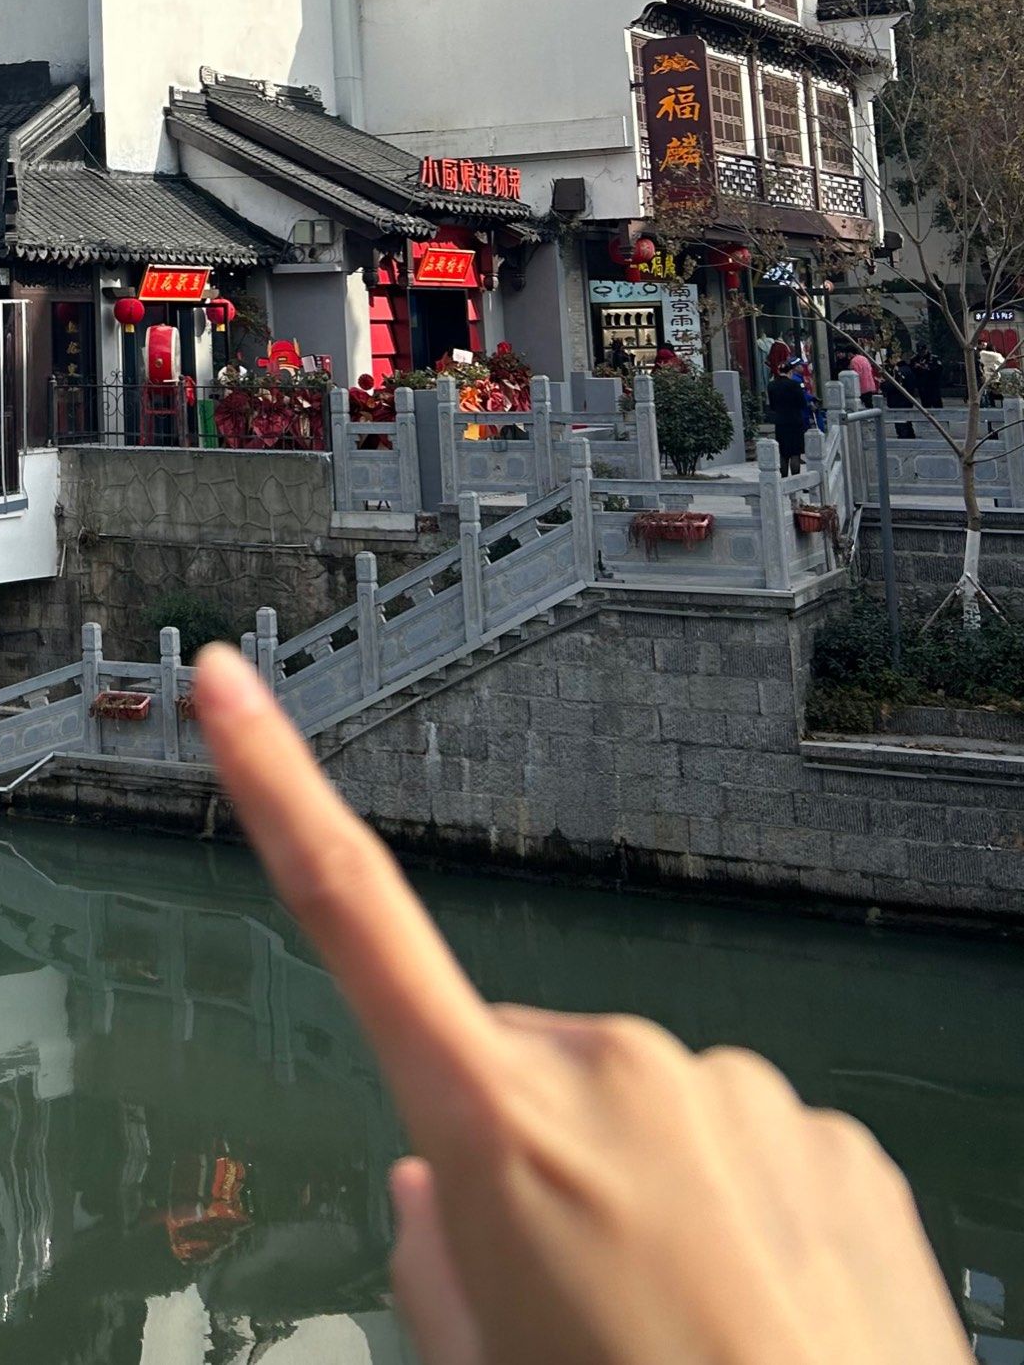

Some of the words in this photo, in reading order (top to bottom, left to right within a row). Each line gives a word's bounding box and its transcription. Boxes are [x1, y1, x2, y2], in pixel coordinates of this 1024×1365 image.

[421, 156, 521, 199] 小厨娘淮扬菜
